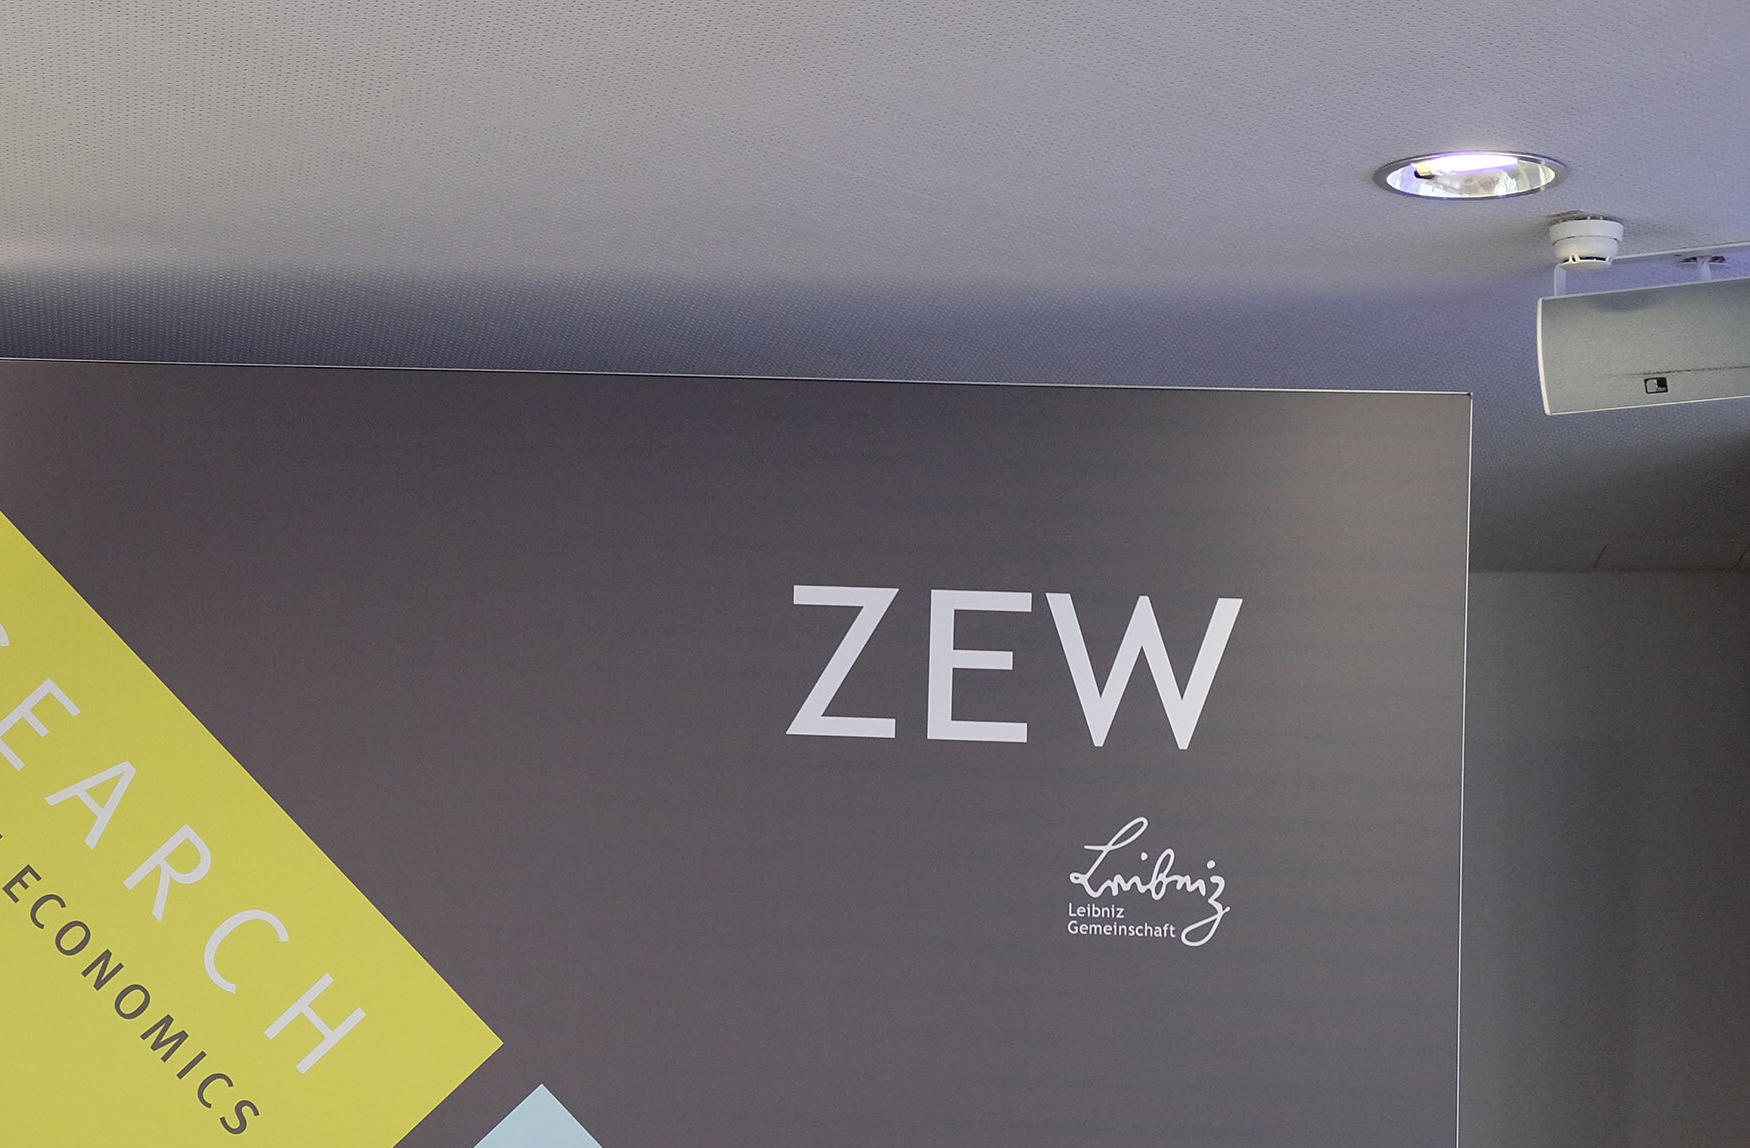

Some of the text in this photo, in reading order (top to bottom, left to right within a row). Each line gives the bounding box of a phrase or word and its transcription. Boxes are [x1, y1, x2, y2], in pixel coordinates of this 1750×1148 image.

[785, 584, 1244, 750] ZEW
[1067, 920, 1176, 938] Gemeinschaft
[1068, 902, 1125, 919] Leibniz
[2, 864, 260, 1135] ECONOMICS
